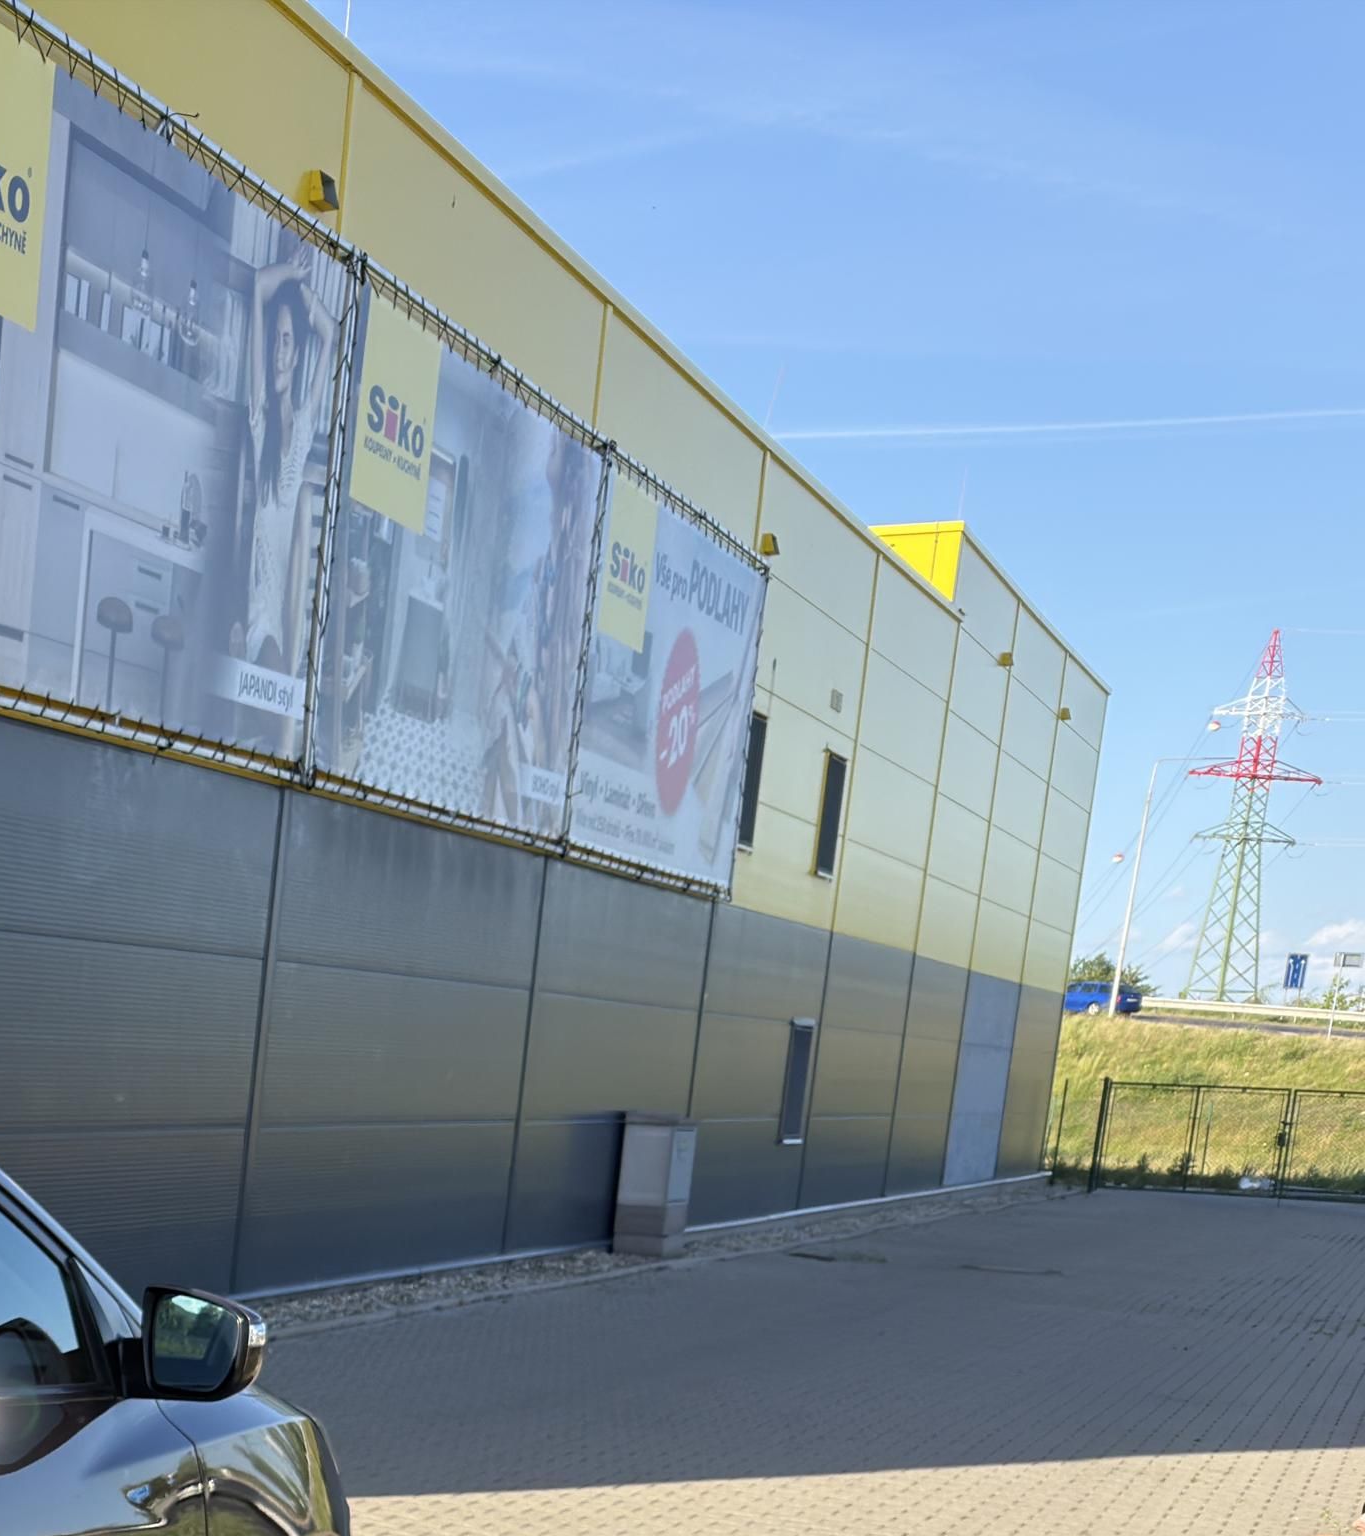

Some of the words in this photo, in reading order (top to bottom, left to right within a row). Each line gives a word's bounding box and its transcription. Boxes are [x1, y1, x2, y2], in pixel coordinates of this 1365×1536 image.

[671, 570, 688, 602] pro
[688, 558, 749, 636] PODLAHY
[238, 671, 278, 703] JAPANDI
[278, 685, 295, 713] styl
